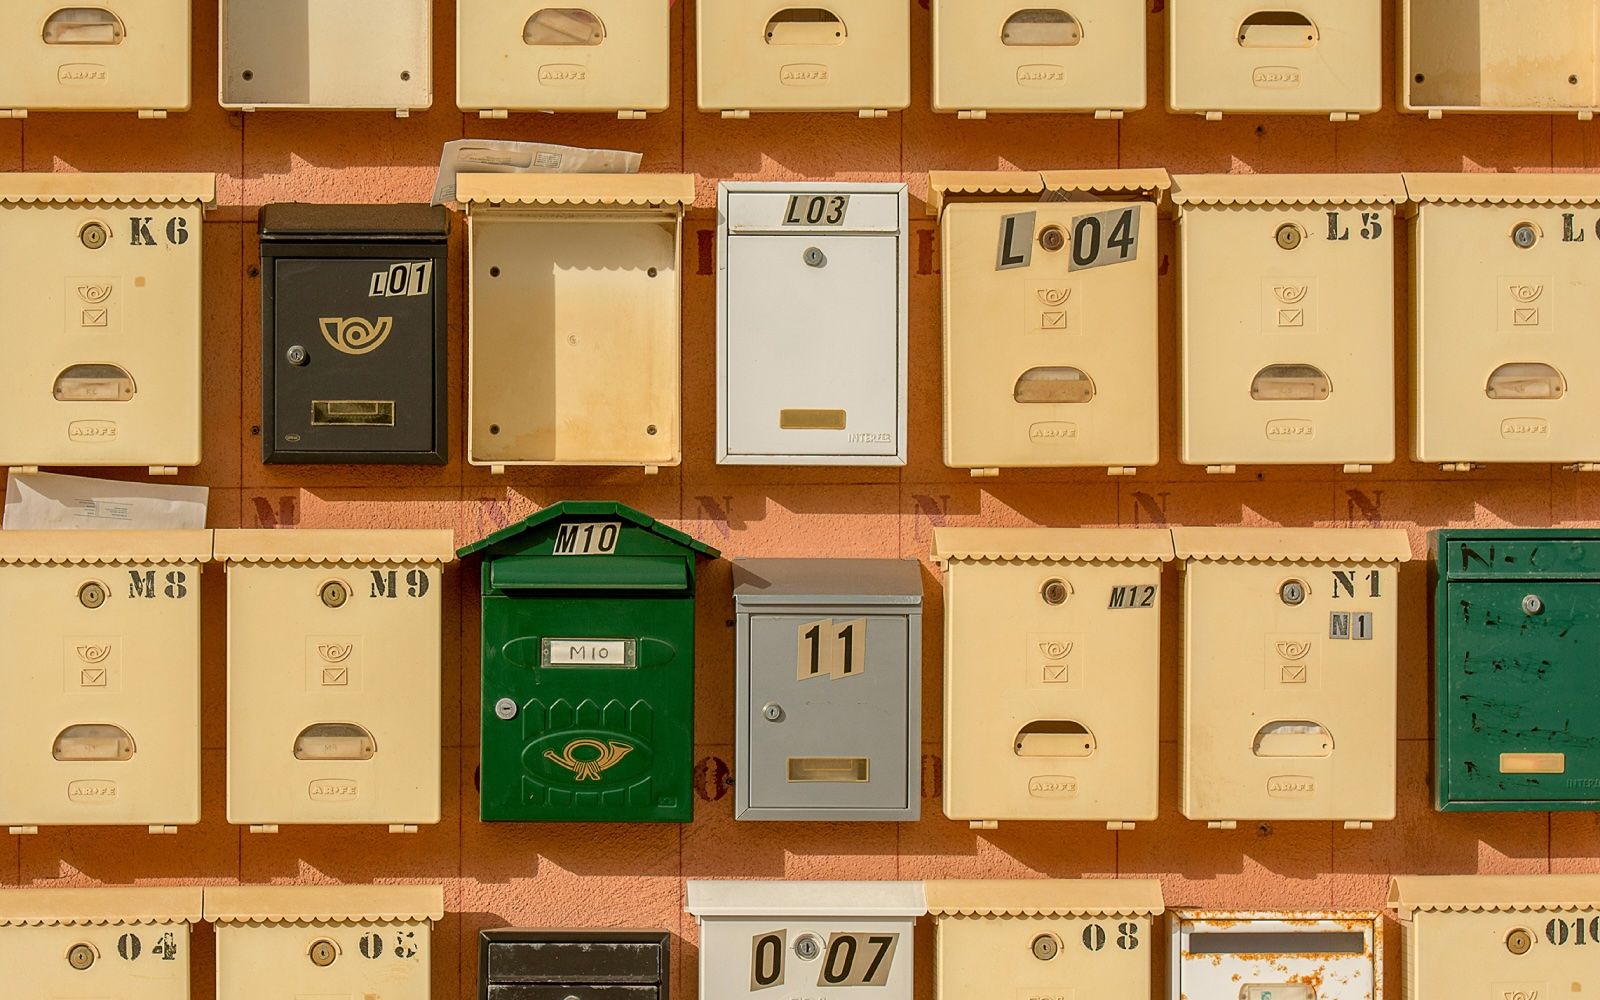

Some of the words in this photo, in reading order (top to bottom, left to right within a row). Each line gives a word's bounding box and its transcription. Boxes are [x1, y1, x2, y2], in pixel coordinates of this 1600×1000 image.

[786, 195, 845, 225] L03
[372, 263, 426, 296] L01
[555, 524, 618, 554] M10
[1109, 585, 1155, 608] M12
